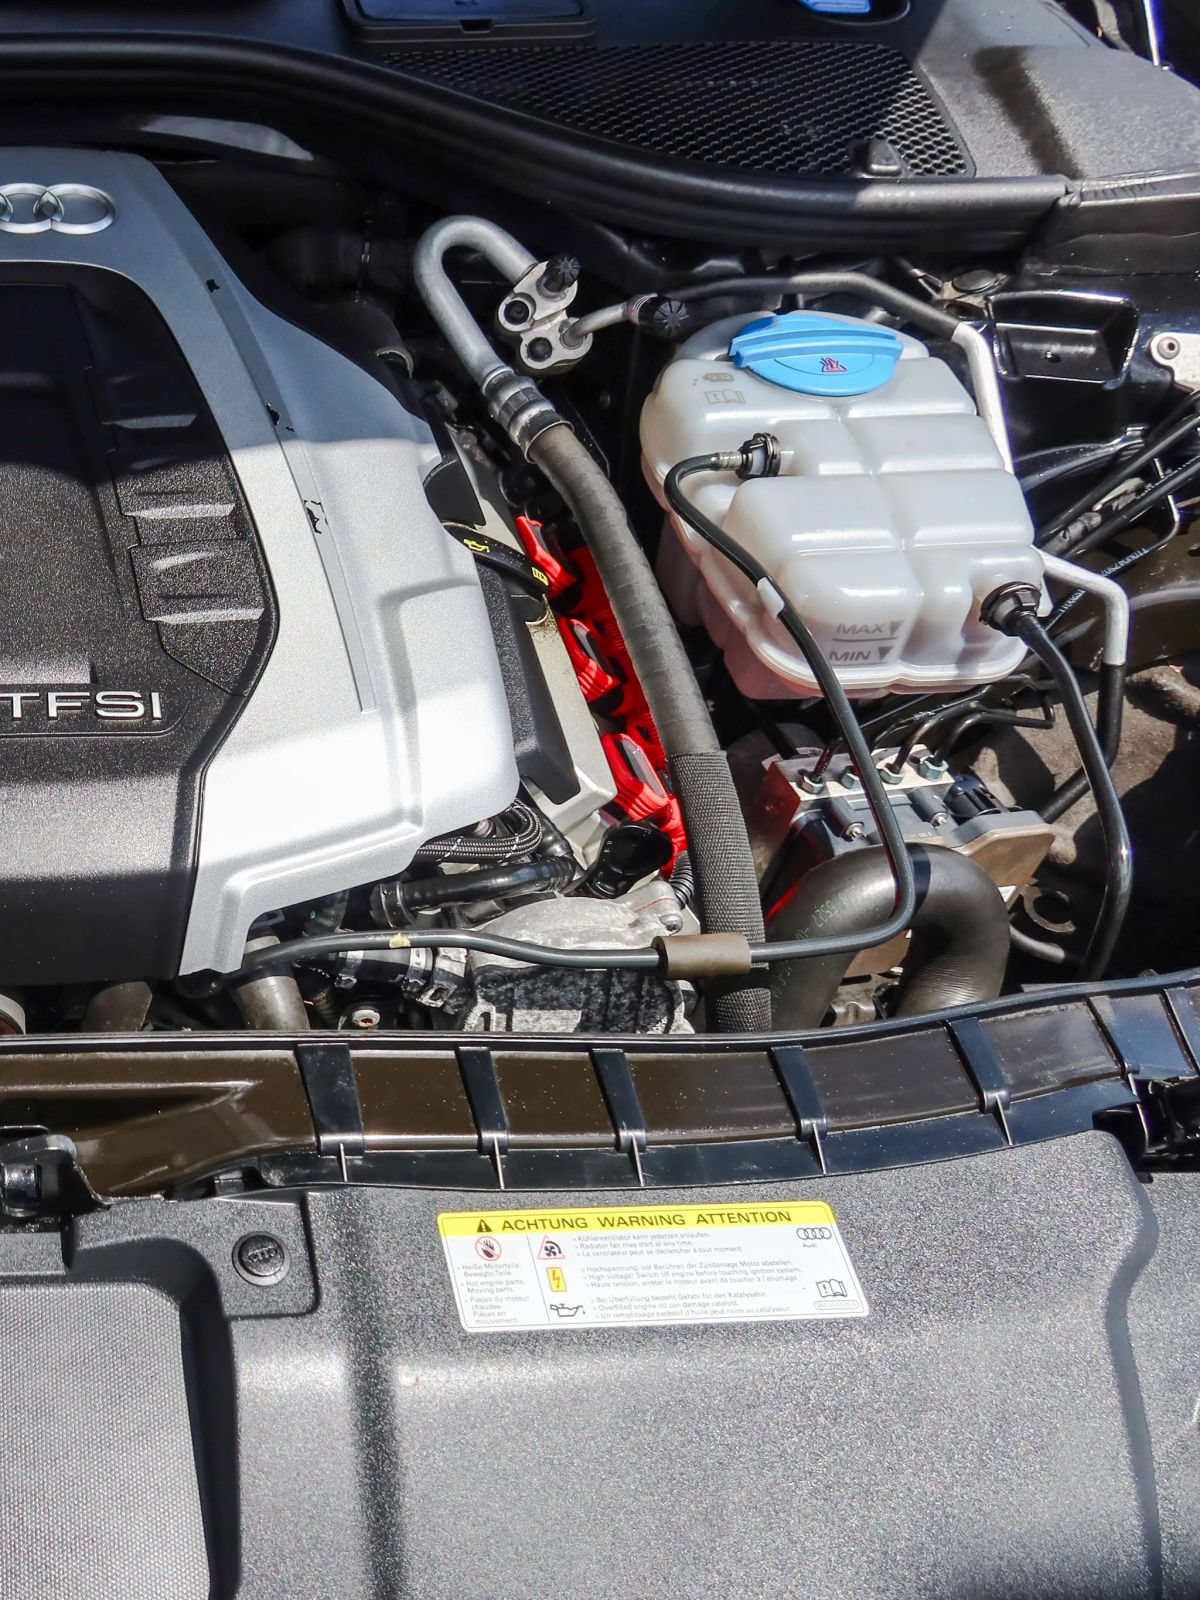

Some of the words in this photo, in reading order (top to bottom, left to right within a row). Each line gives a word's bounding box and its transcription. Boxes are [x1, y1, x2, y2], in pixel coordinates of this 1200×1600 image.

[837, 624, 885, 634] MAX
[829, 650, 871, 661] MIN
[502, 1218, 588, 1231] ACHTUNG
[597, 1214, 686, 1228] WARNING
[696, 1212, 792, 1224] ATTENTION
